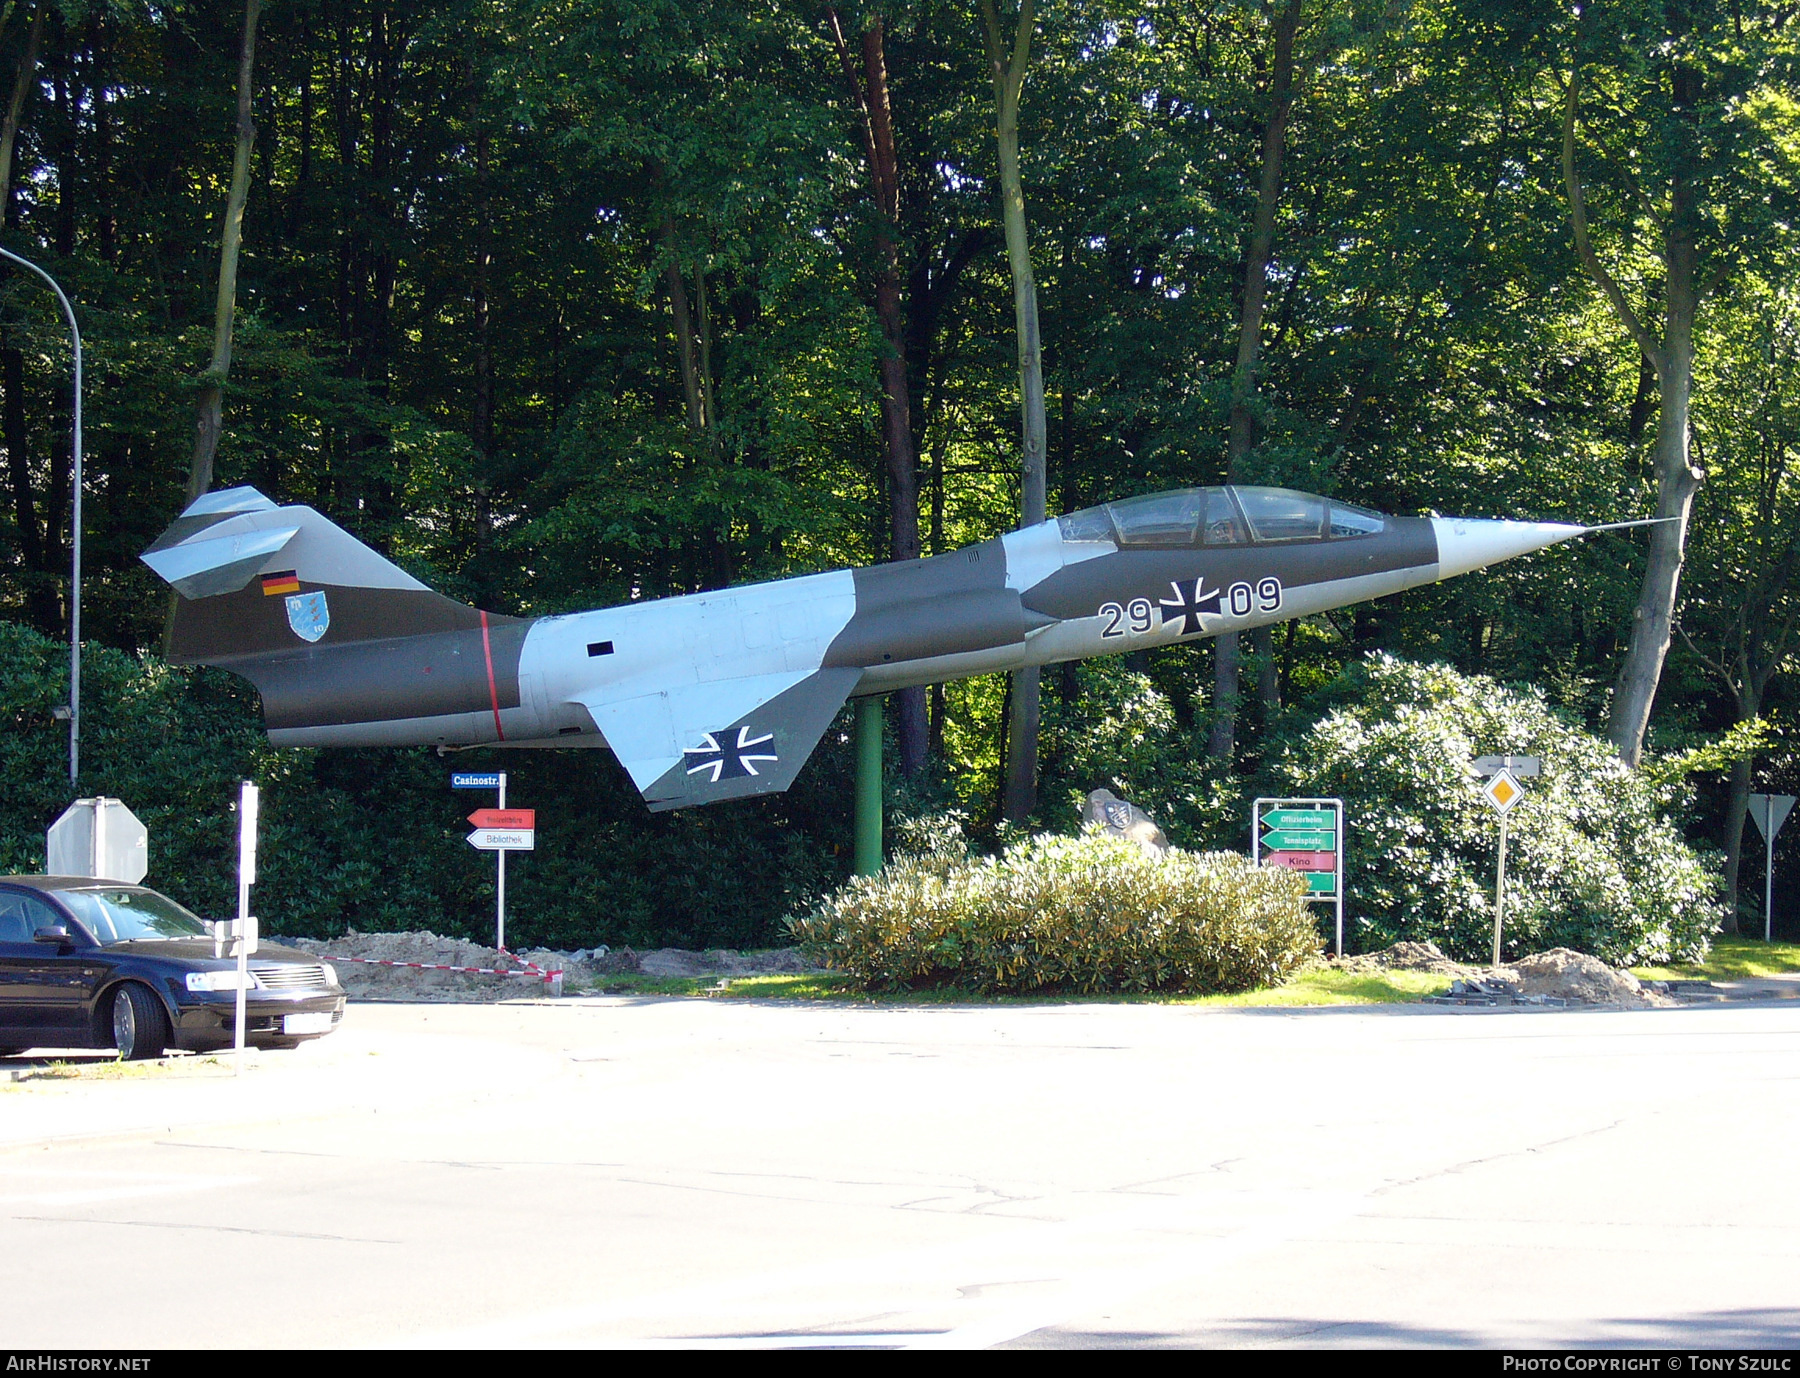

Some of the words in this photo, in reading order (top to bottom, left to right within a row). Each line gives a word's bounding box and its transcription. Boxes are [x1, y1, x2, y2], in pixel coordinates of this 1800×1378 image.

[1098, 598, 1154, 639] 29
[1228, 576, 1282, 617] 09
[453, 775, 499, 785] Casinostr.
[486, 834, 523, 844] Bibliothek
[1288, 857, 1311, 866] Kino
